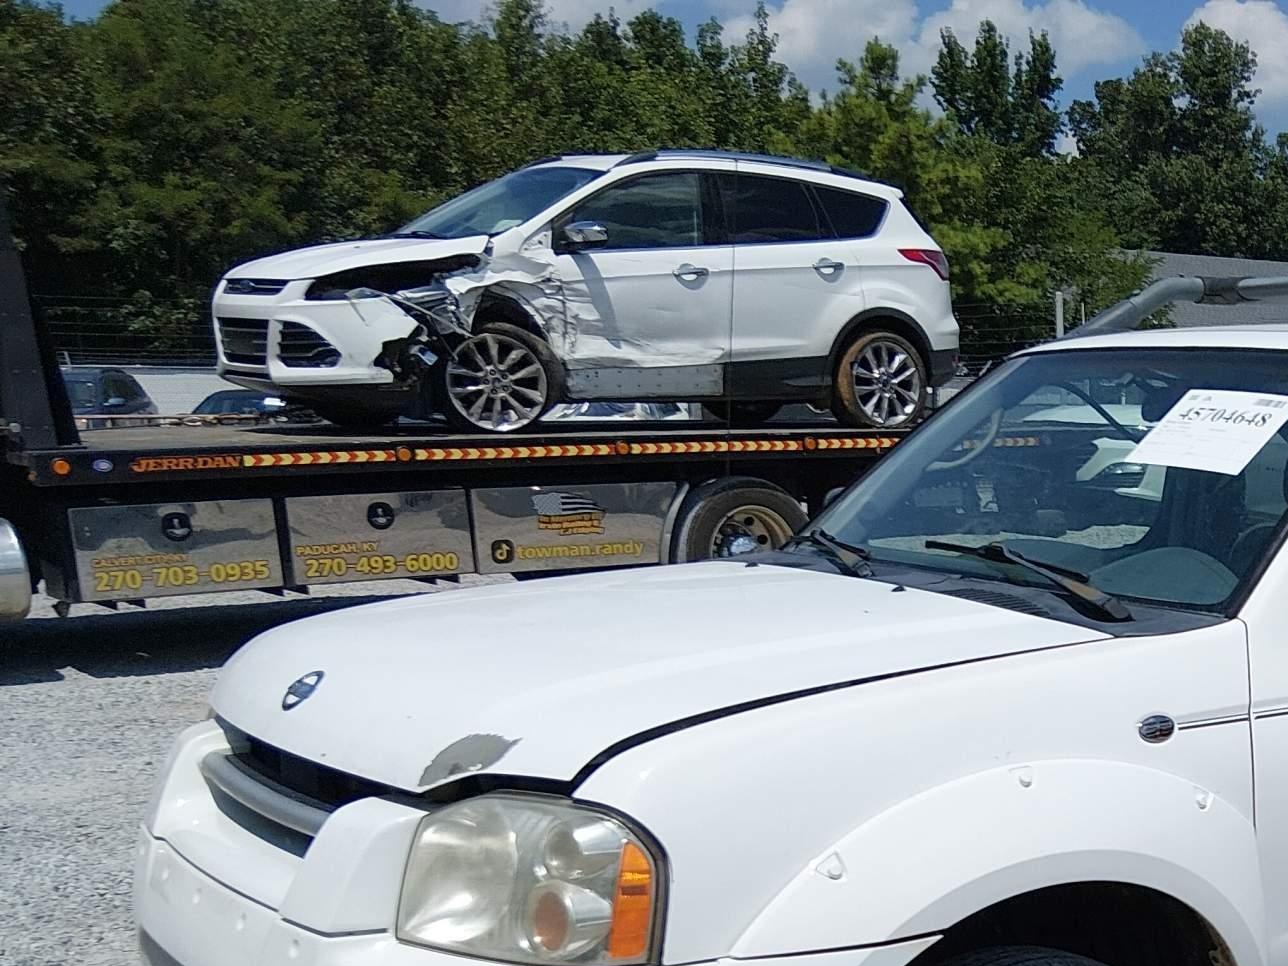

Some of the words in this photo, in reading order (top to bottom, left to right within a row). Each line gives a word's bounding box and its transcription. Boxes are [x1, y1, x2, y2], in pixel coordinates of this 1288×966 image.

[1179, 407, 1273, 428] 45704648
[362, 541, 380, 553] KY
[516, 539, 645, 560] towman.randy
[305, 552, 459, 578] 270-493-6000
[94, 560, 271, 592] 270-703-0935
